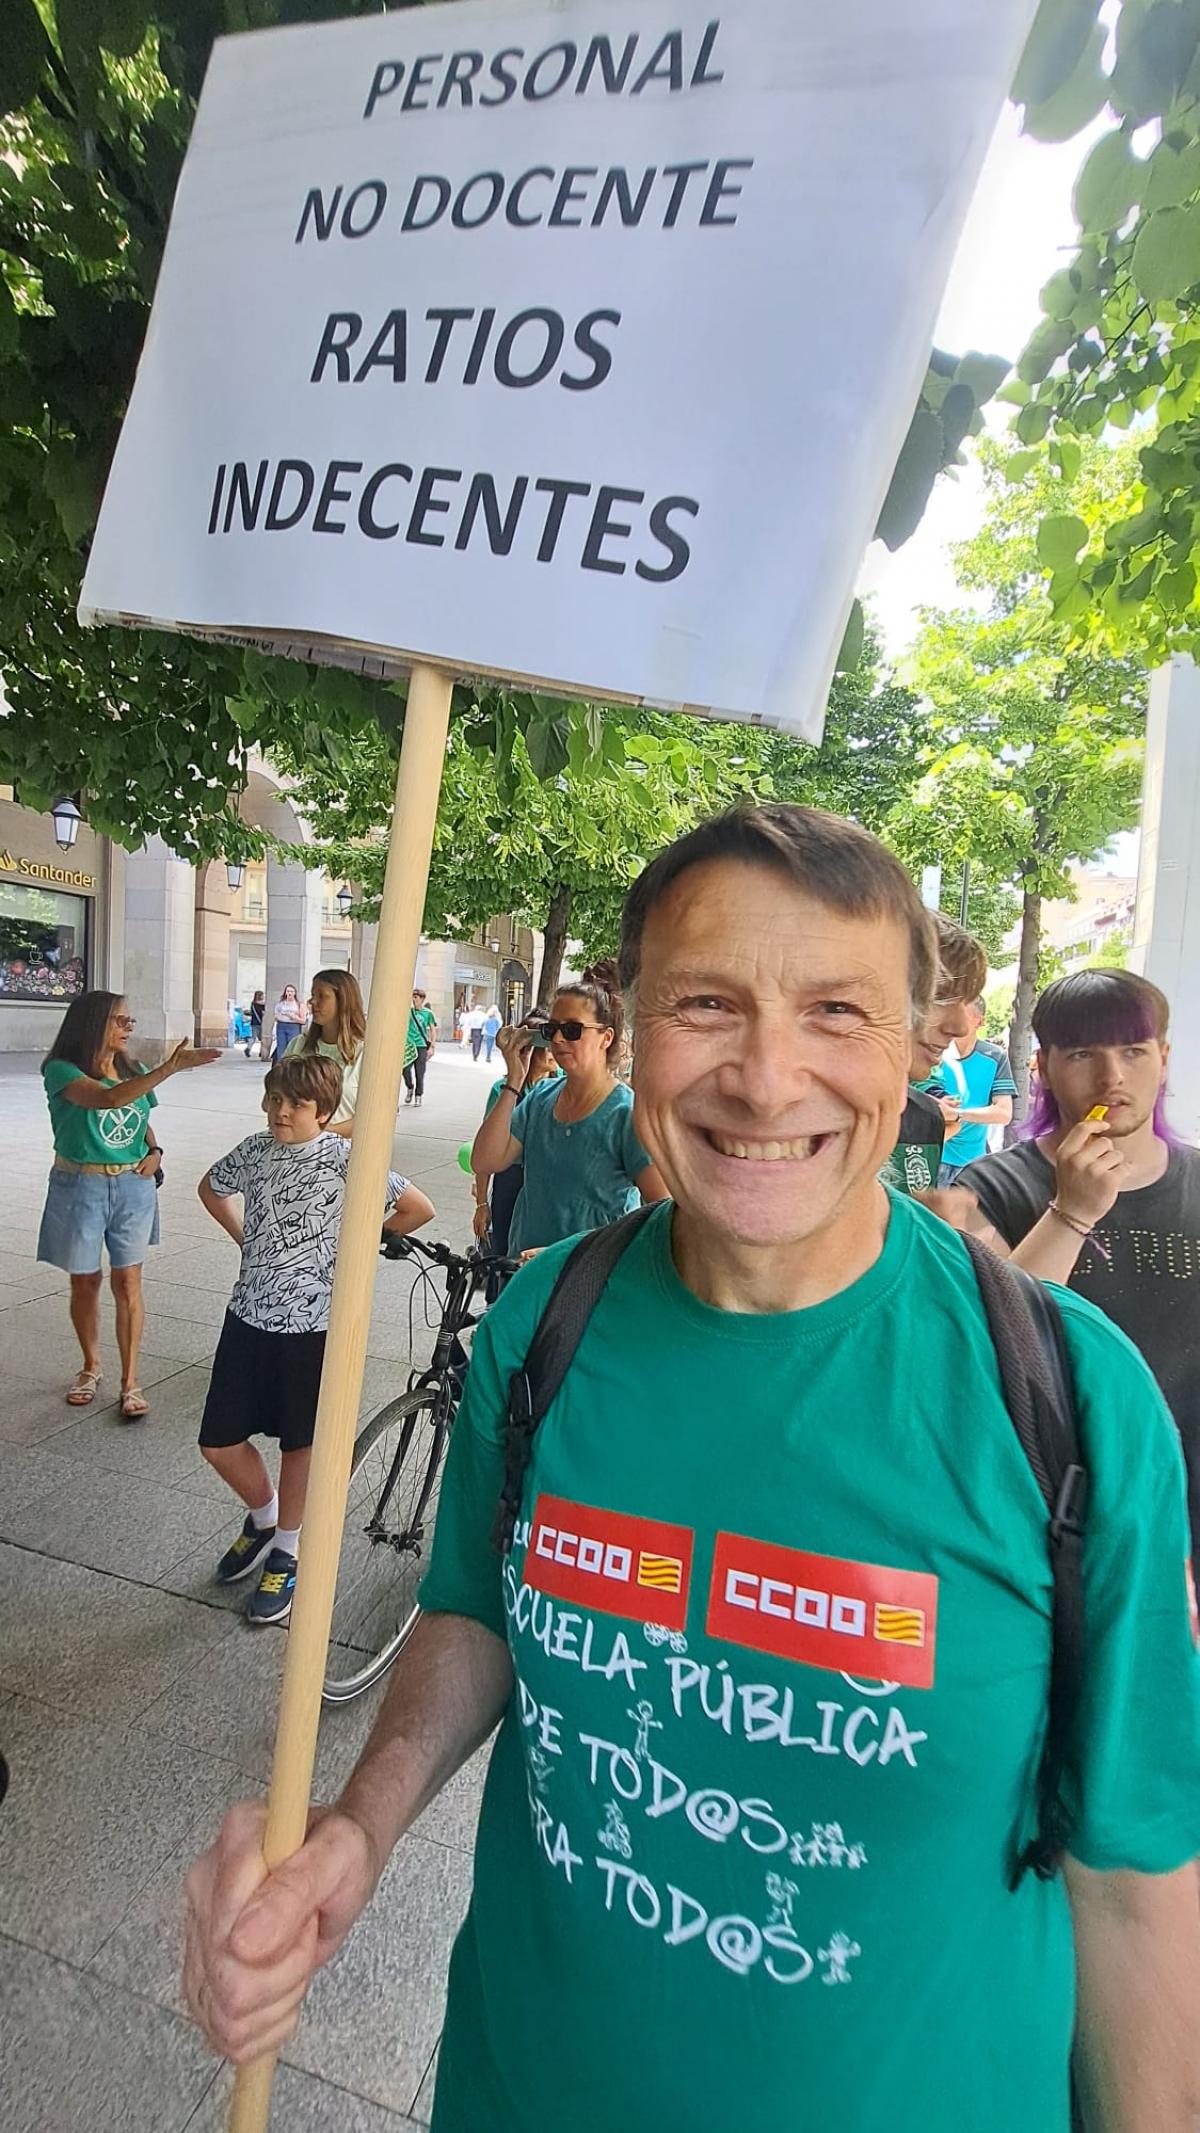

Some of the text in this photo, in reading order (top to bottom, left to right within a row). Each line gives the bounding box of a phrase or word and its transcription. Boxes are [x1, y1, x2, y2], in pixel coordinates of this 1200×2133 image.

[363, 20, 726, 119] PERSONAL
[295, 158, 754, 244] NO DOCENTE
[310, 307, 622, 391] RATIOS
[208, 459, 700, 583] INDECENTES
[19, 858, 97, 888] Santander
[1073, 1225, 1200, 1279] TRO
[535, 1524, 633, 1583] CCOO
[725, 1568, 867, 1637] CCOO
[665, 1660, 929, 1768] PÚBLICA
[518, 1677, 790, 1855] DE TOD@S
[527, 1778, 815, 1985] RA TOD@S
